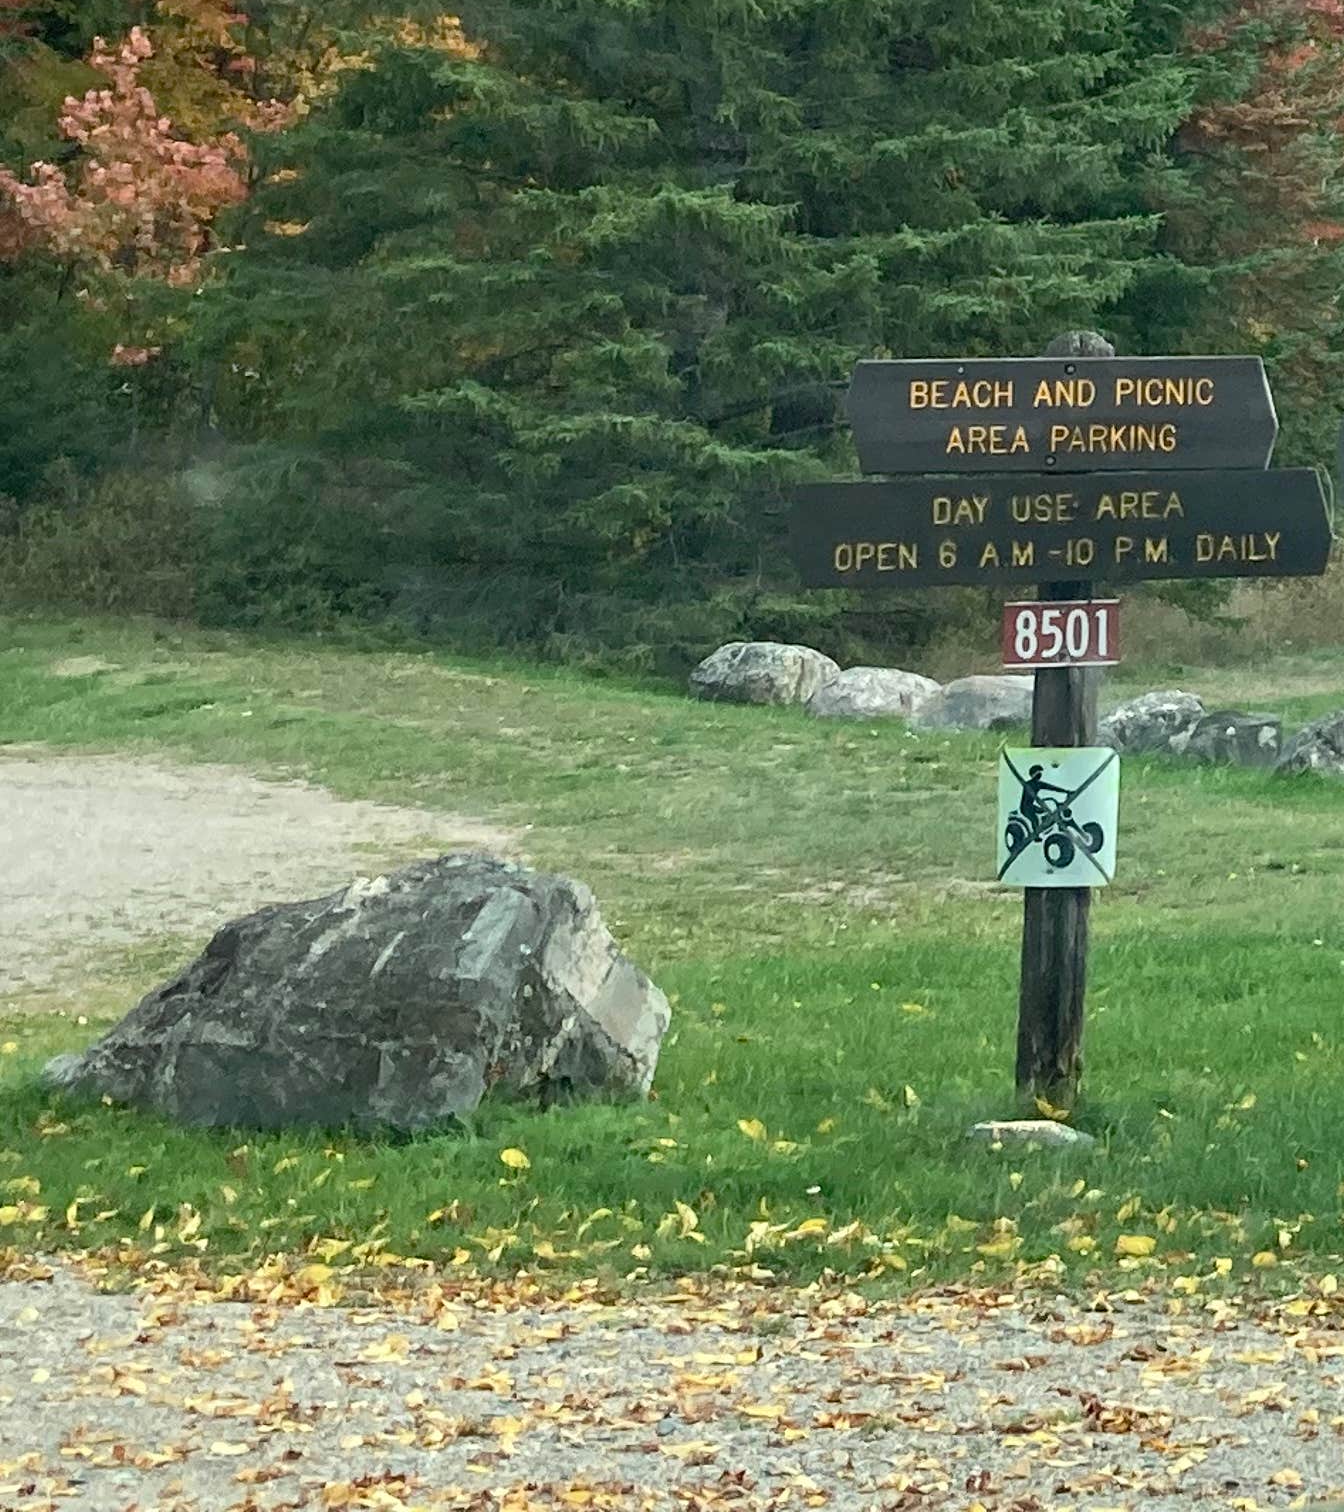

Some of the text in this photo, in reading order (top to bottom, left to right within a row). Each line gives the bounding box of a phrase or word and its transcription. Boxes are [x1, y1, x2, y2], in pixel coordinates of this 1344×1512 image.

[909, 377, 1215, 408] BEACH AND PICNIC
[946, 423, 1177, 453] AREA PARKING
[933, 491, 1185, 525] DAY USE AREA
[835, 542, 919, 572] OPEN
[938, 540, 957, 568] 6
[1197, 532, 1281, 562] DAILY
[1015, 609, 1108, 659] 8501
